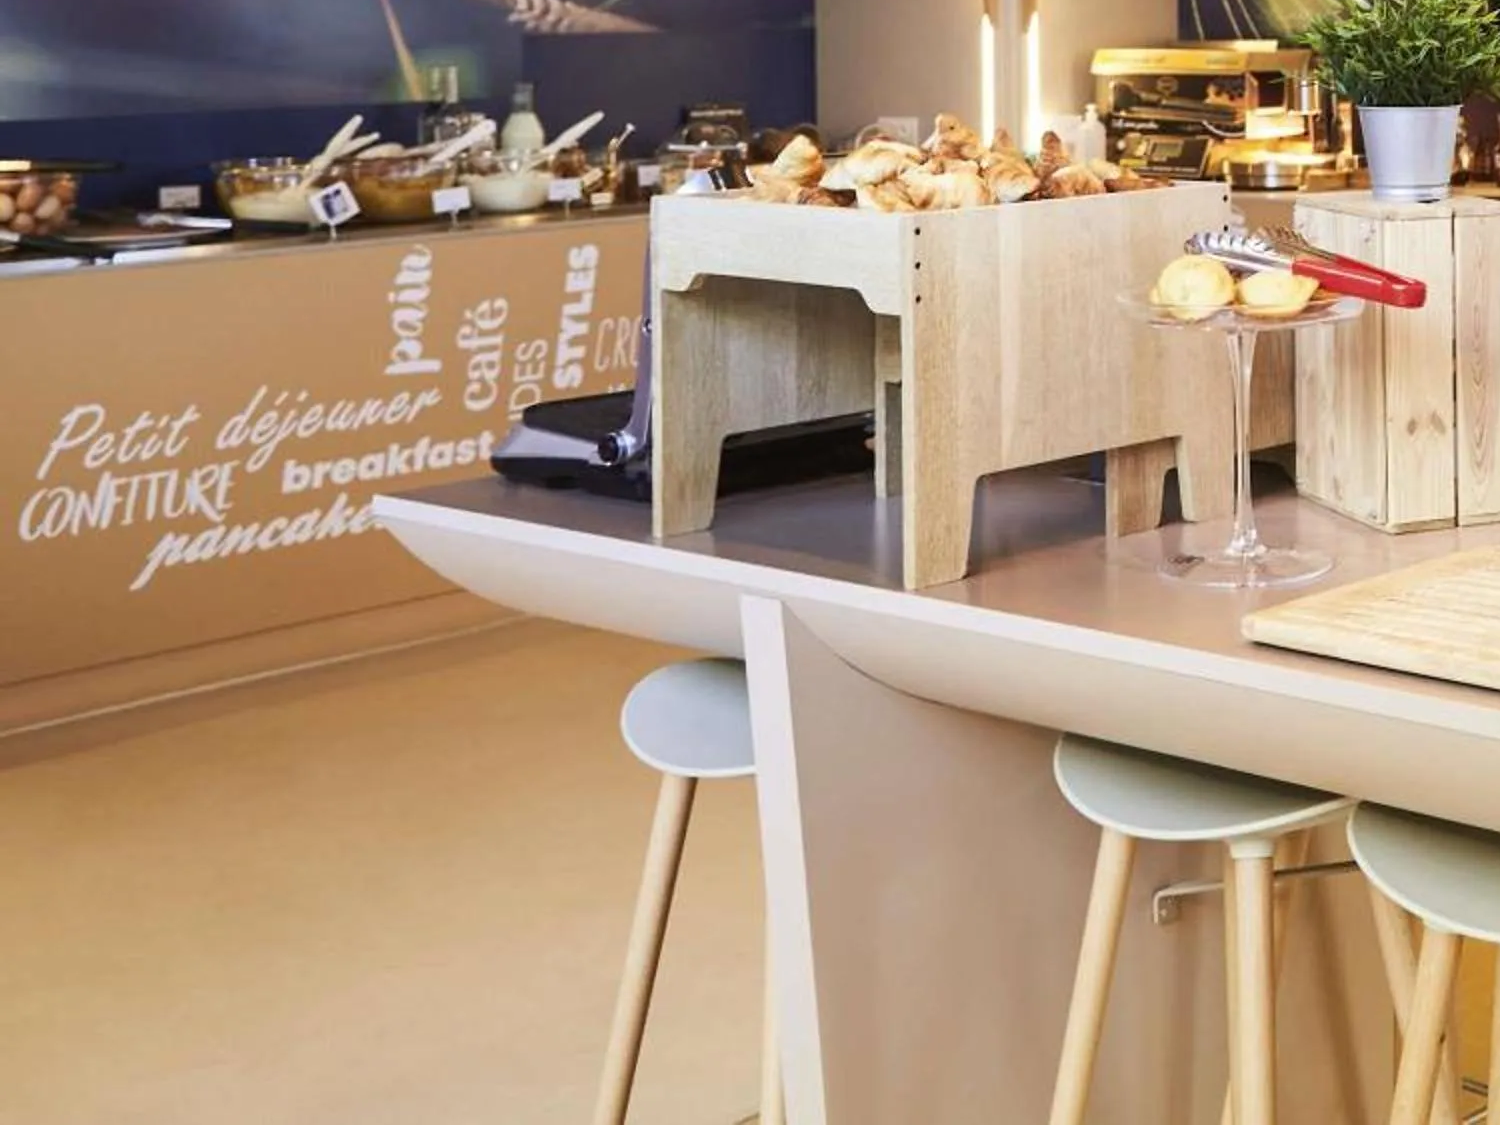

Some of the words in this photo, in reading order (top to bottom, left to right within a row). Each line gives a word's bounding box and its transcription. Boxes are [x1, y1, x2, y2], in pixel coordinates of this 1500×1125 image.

[384, 243, 442, 375] pain
[457, 297, 508, 411] café
[552, 244, 599, 389] STYLES
[37, 404, 201, 480] Petit
[215, 384, 442, 473] déjeuner
[281, 431, 495, 494] breakfast
[18, 459, 241, 542] CONFITURE
[129, 492, 387, 591] pancake
